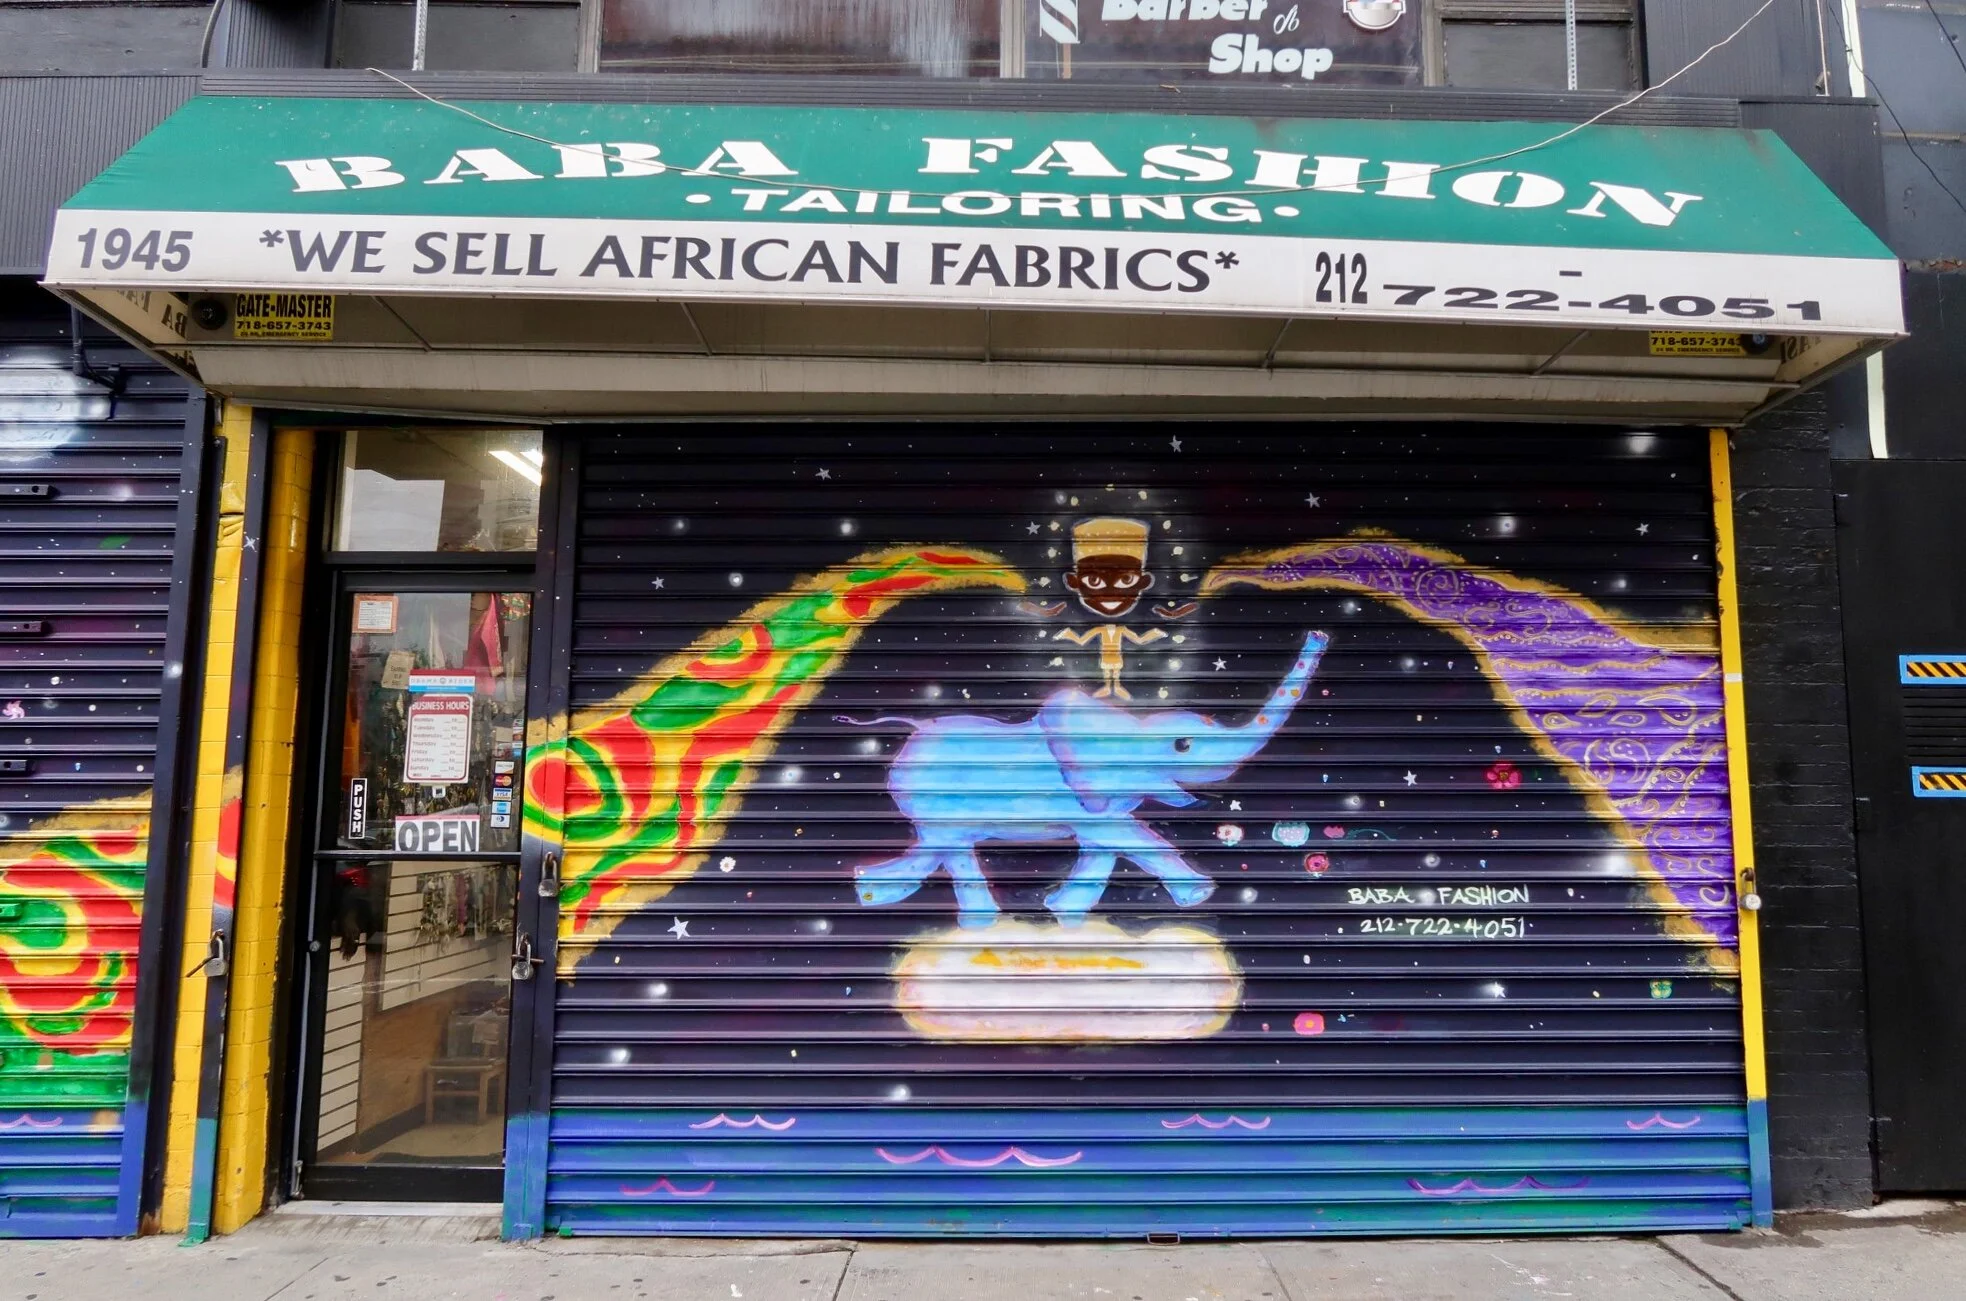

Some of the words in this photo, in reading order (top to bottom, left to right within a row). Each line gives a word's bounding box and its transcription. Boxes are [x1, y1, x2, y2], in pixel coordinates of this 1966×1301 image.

[1208, 33, 1334, 80] Shop
[275, 140, 799, 193] BABA
[917, 137, 1703, 227] FASHION
[76, 228, 193, 272] 1945
[413, 231, 557, 276] SELL
[579, 233, 900, 284] AFRICAN
[236, 293, 332, 318] GATE-MASTER
[1315, 251, 1368, 304] 212
[1383, 283, 1822, 321] 722-4051
[236, 321, 331, 331] 718-657-3743
[411, 701, 444, 711] BUSINESS
[445, 701, 470, 711] HOURS
[352, 784, 363, 833] PUSH
[398, 821, 477, 852] OPEN
[1348, 886, 1415, 905] BABA
[1437, 884, 1529, 906] FASHION
